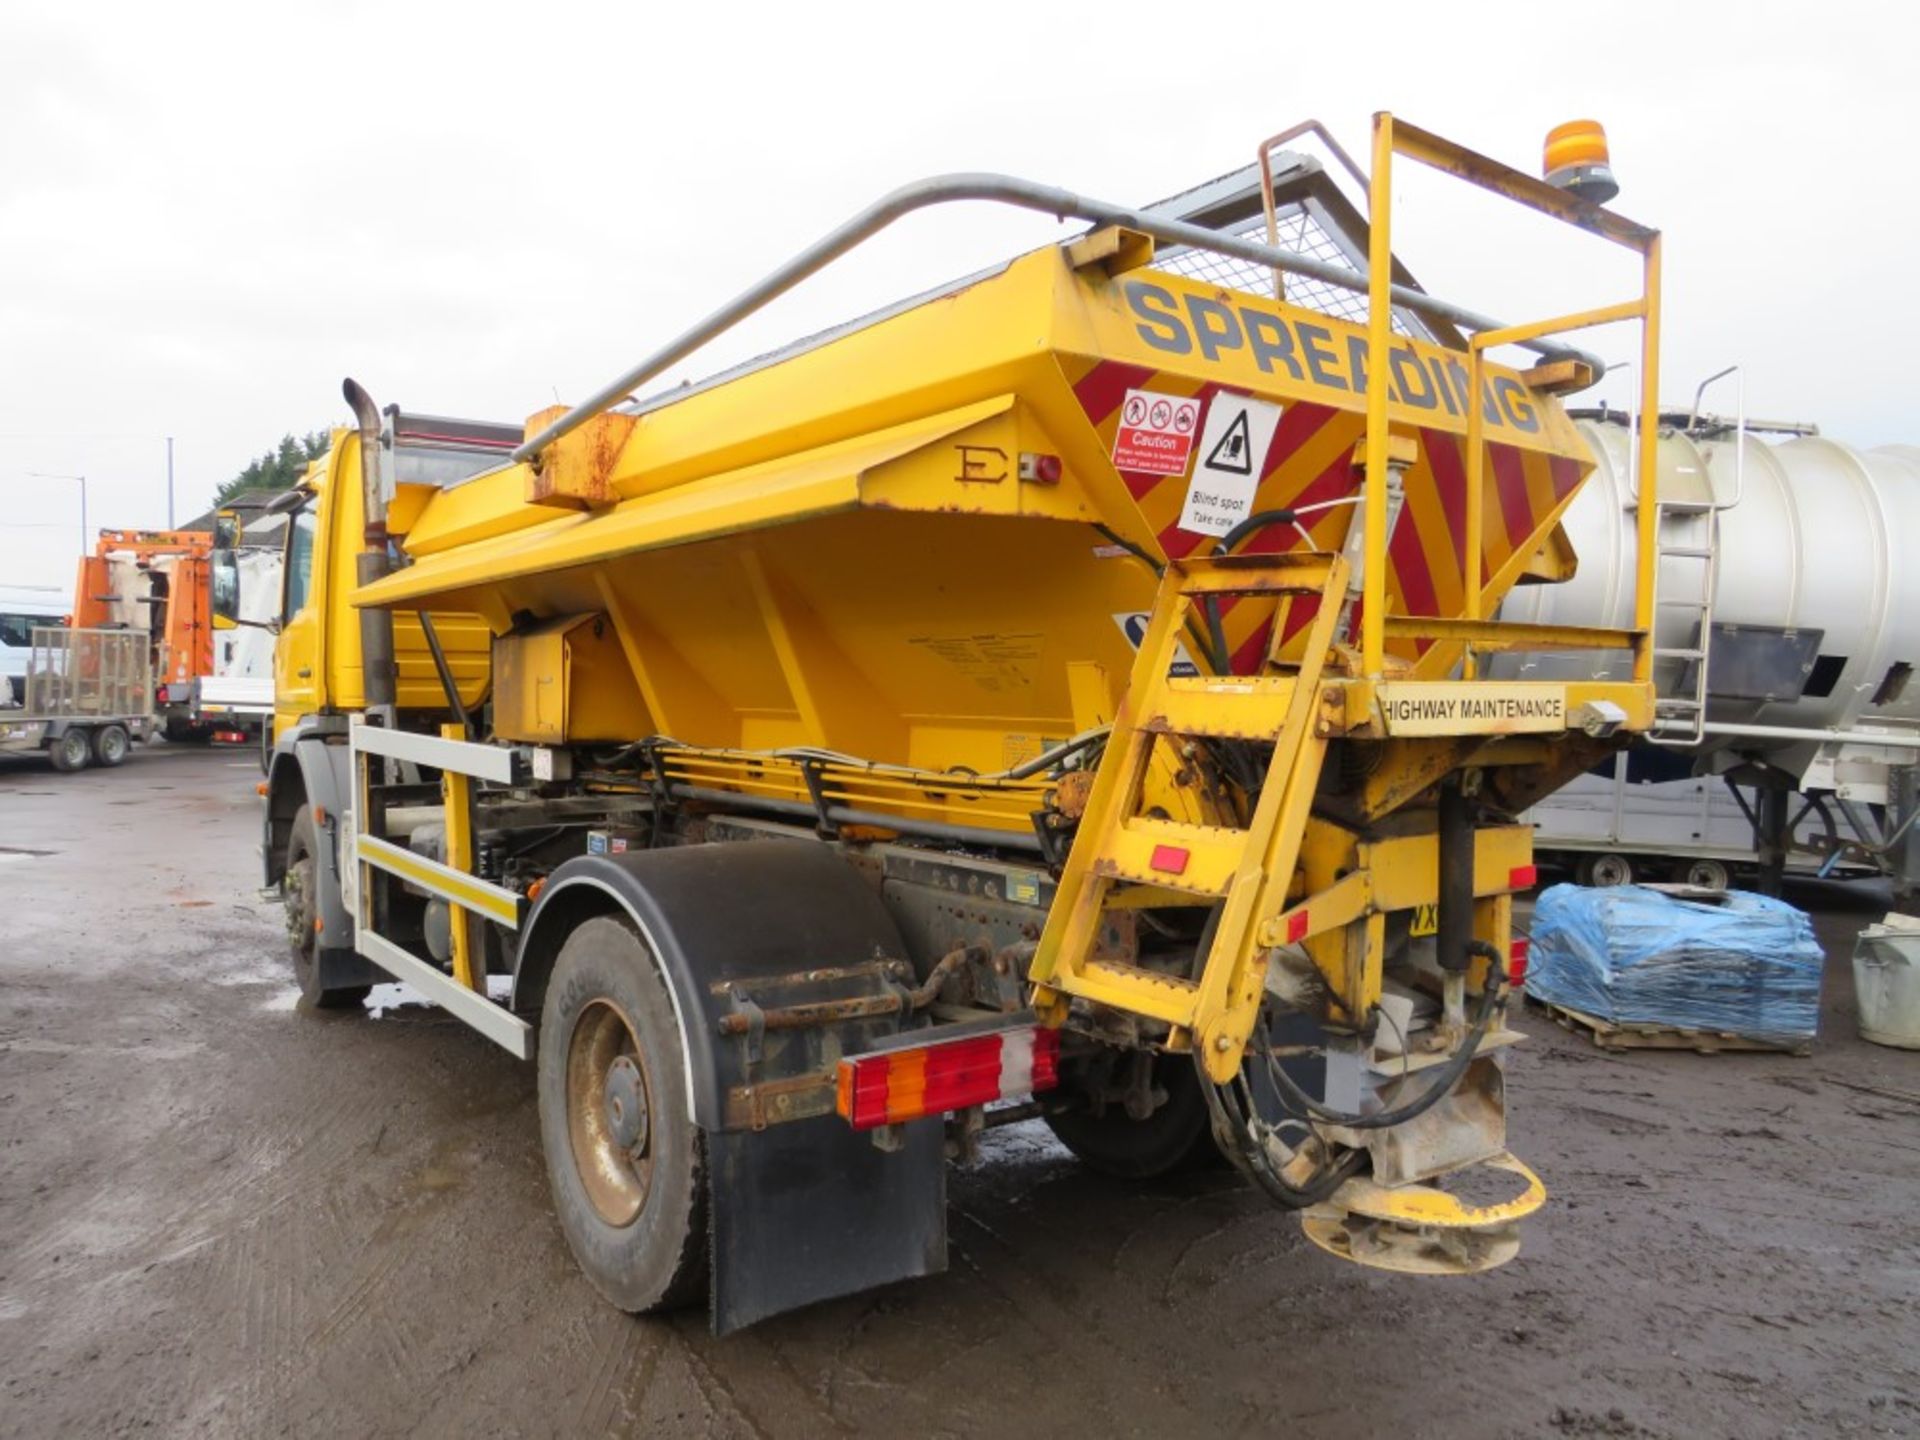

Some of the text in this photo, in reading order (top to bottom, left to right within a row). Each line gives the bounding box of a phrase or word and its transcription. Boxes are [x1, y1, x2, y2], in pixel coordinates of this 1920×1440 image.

[1125, 279, 1540, 434] SPREADING
[1132, 431, 1177, 450] Caution
[1192, 491, 1245, 512] Blind spot
[1193, 511, 1233, 527] Take care
[1383, 699, 1561, 721] HIGHWAY MAINTENANCE
